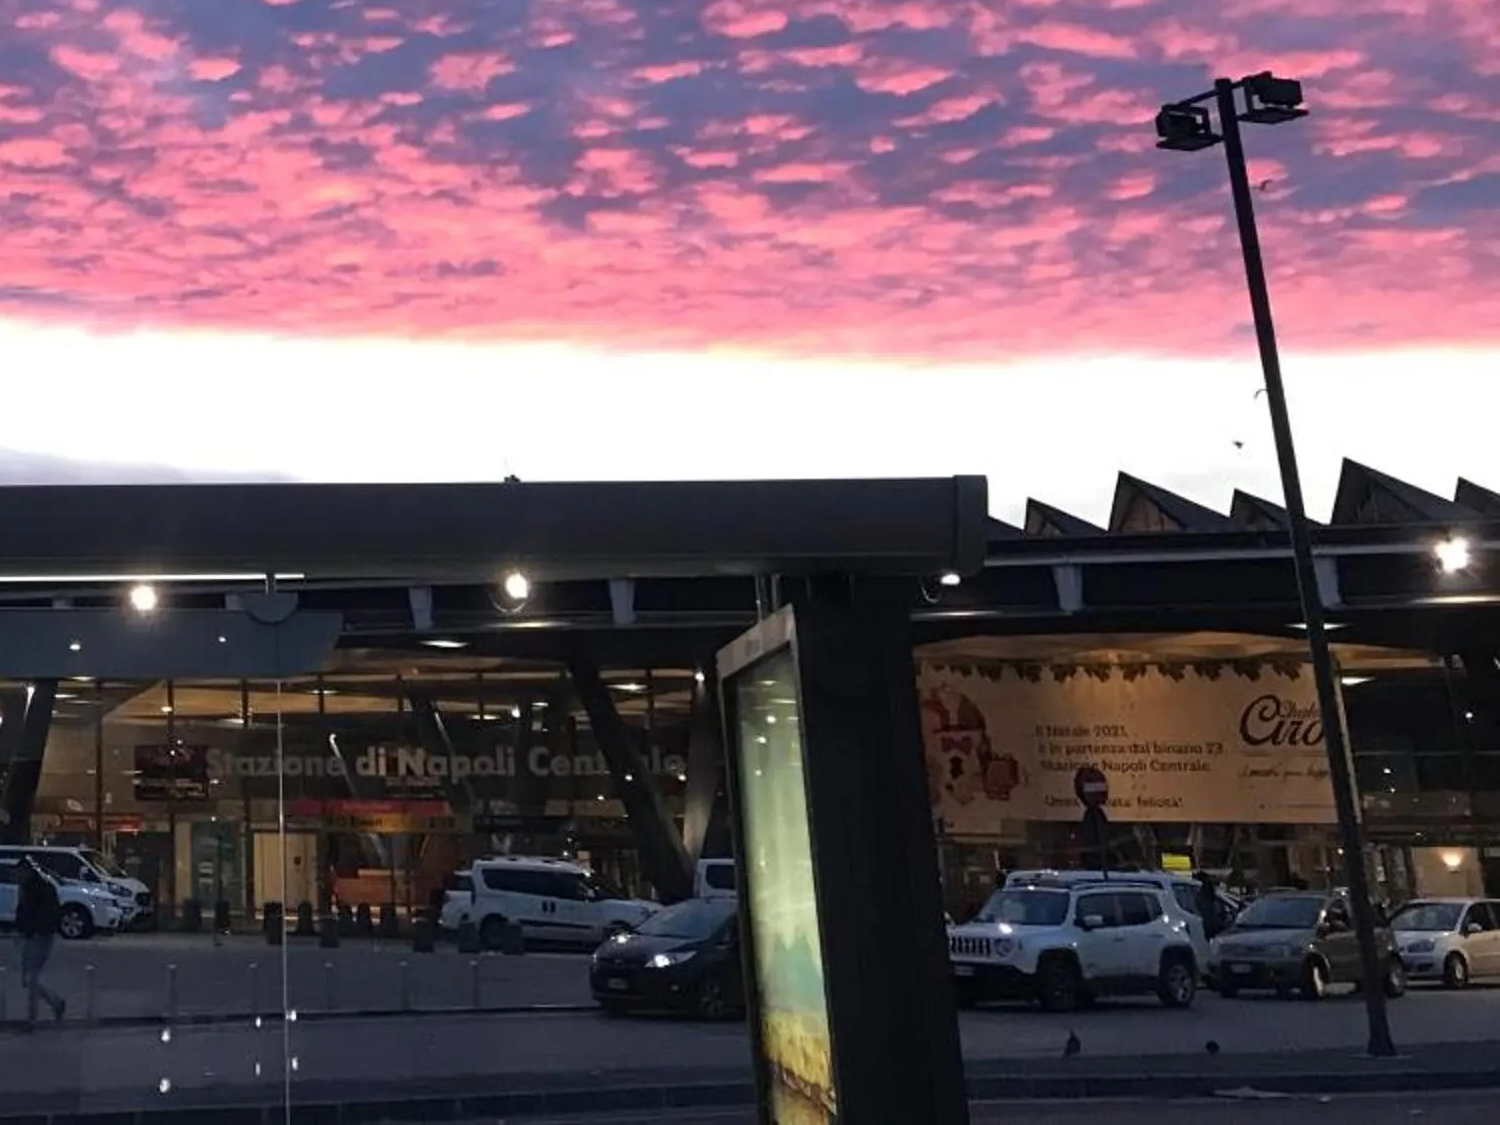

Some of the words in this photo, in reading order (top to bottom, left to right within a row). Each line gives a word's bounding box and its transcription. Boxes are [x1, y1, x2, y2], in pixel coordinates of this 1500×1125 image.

[1240, 695, 1323, 745] Ciro
[1153, 741, 1203, 754] binario
[205, 747, 346, 779] Stazione
[355, 746, 387, 777] di
[397, 745, 515, 784] Napoli
[1102, 759, 1147, 774] Napoli
